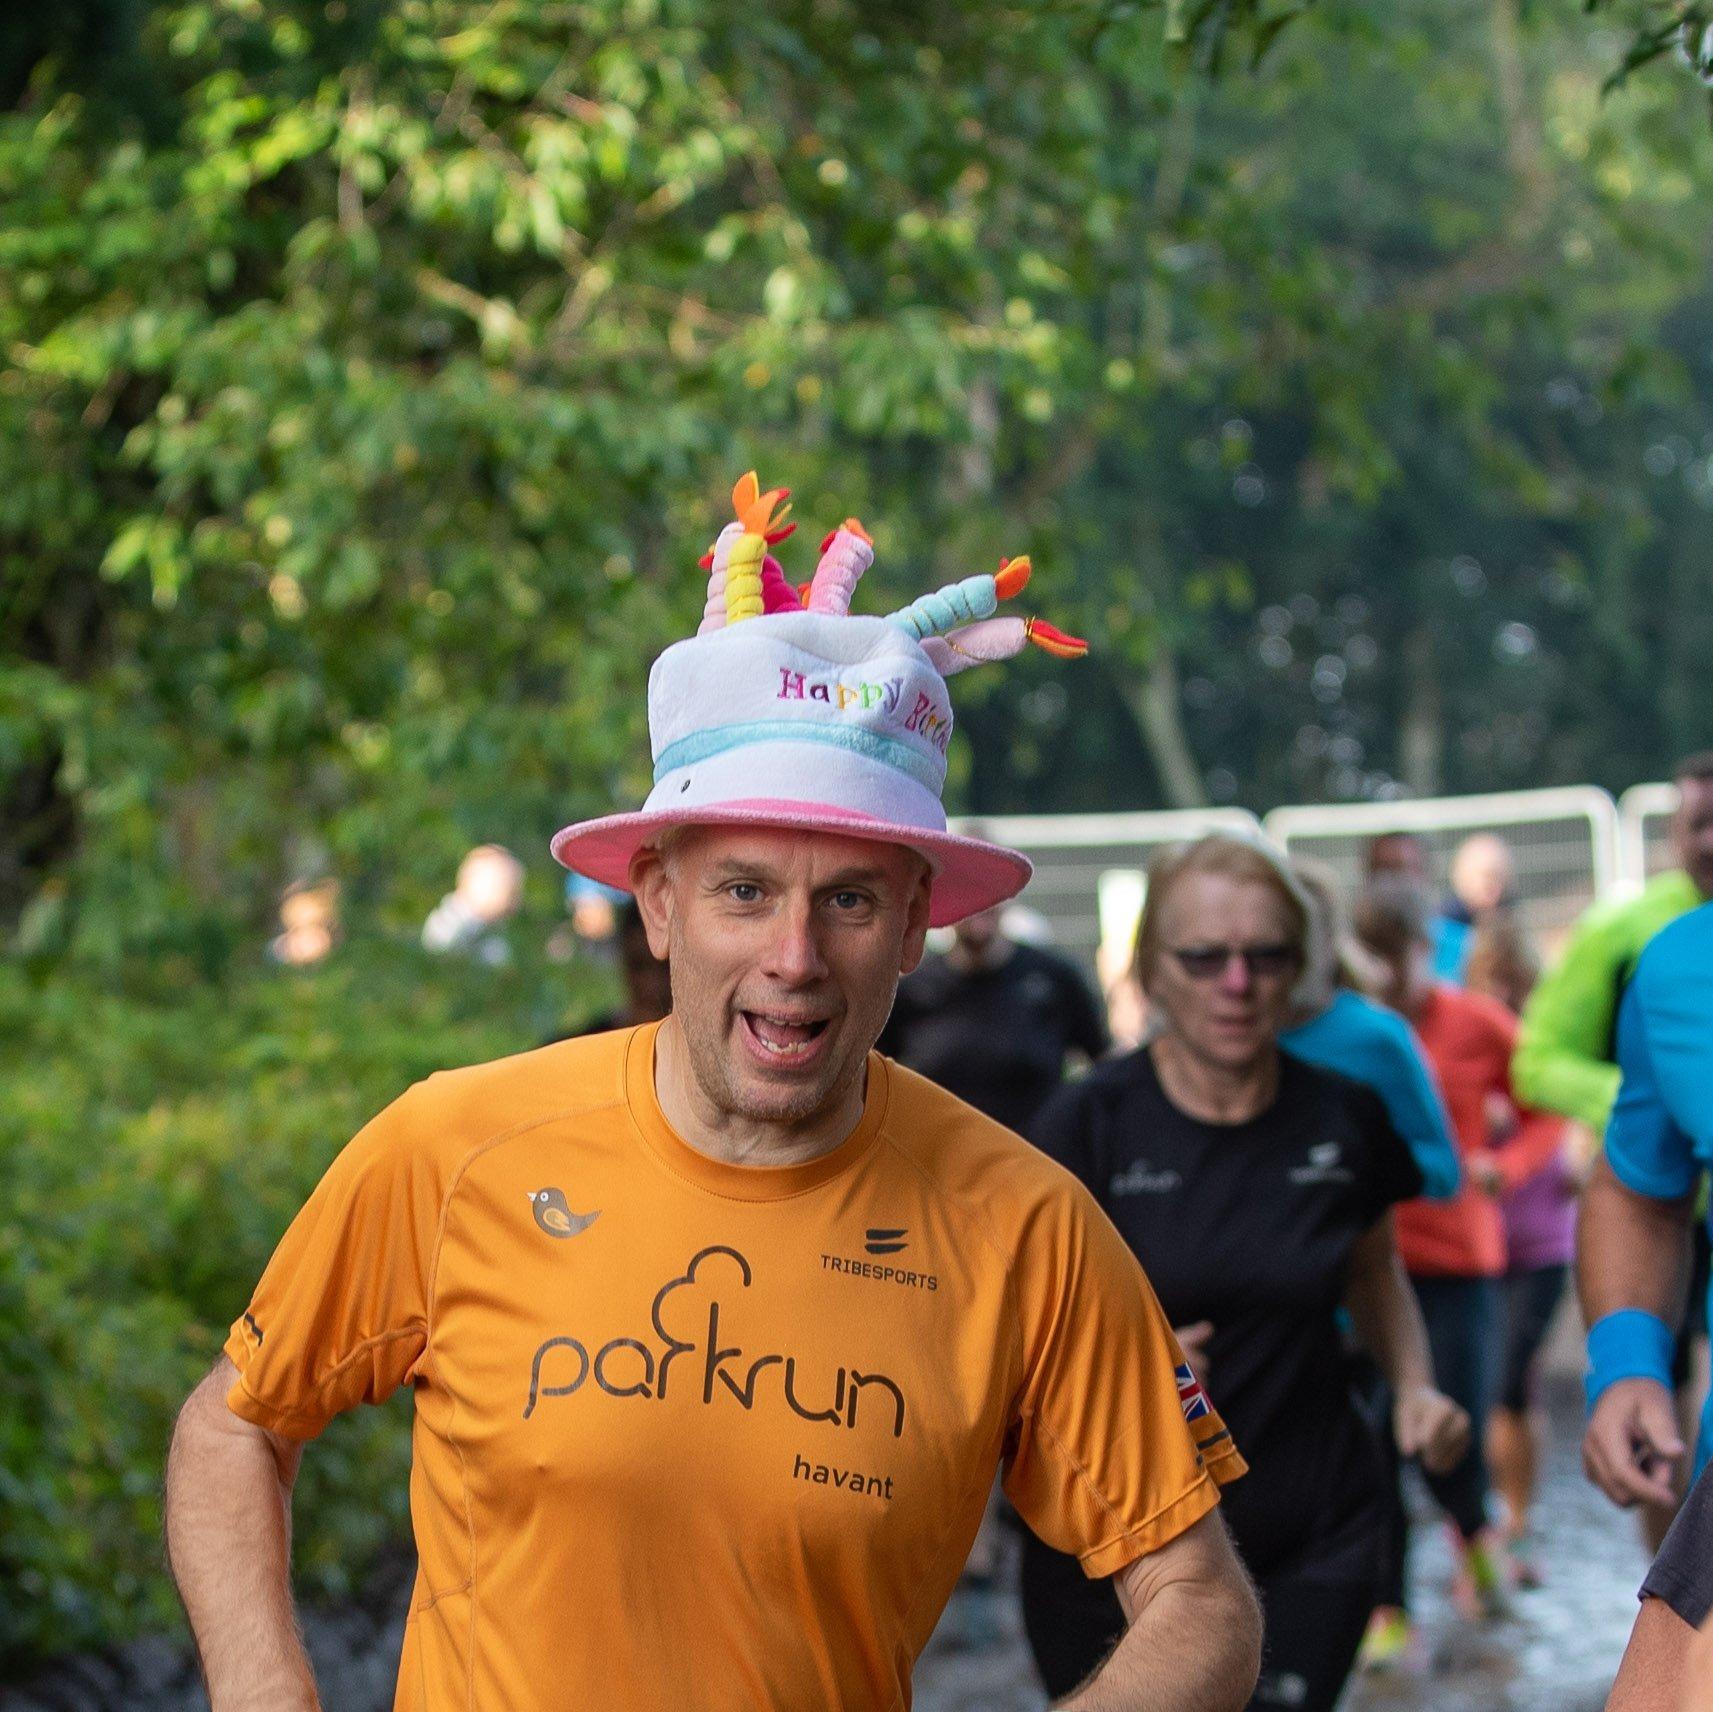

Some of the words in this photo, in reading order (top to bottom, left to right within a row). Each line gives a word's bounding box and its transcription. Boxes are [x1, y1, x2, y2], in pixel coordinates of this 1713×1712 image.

[777, 666, 904, 714] Happy
[820, 1254, 938, 1292] TRIBESPORTS
[522, 1244, 906, 1438] parkrun
[792, 1453, 894, 1500] havant
